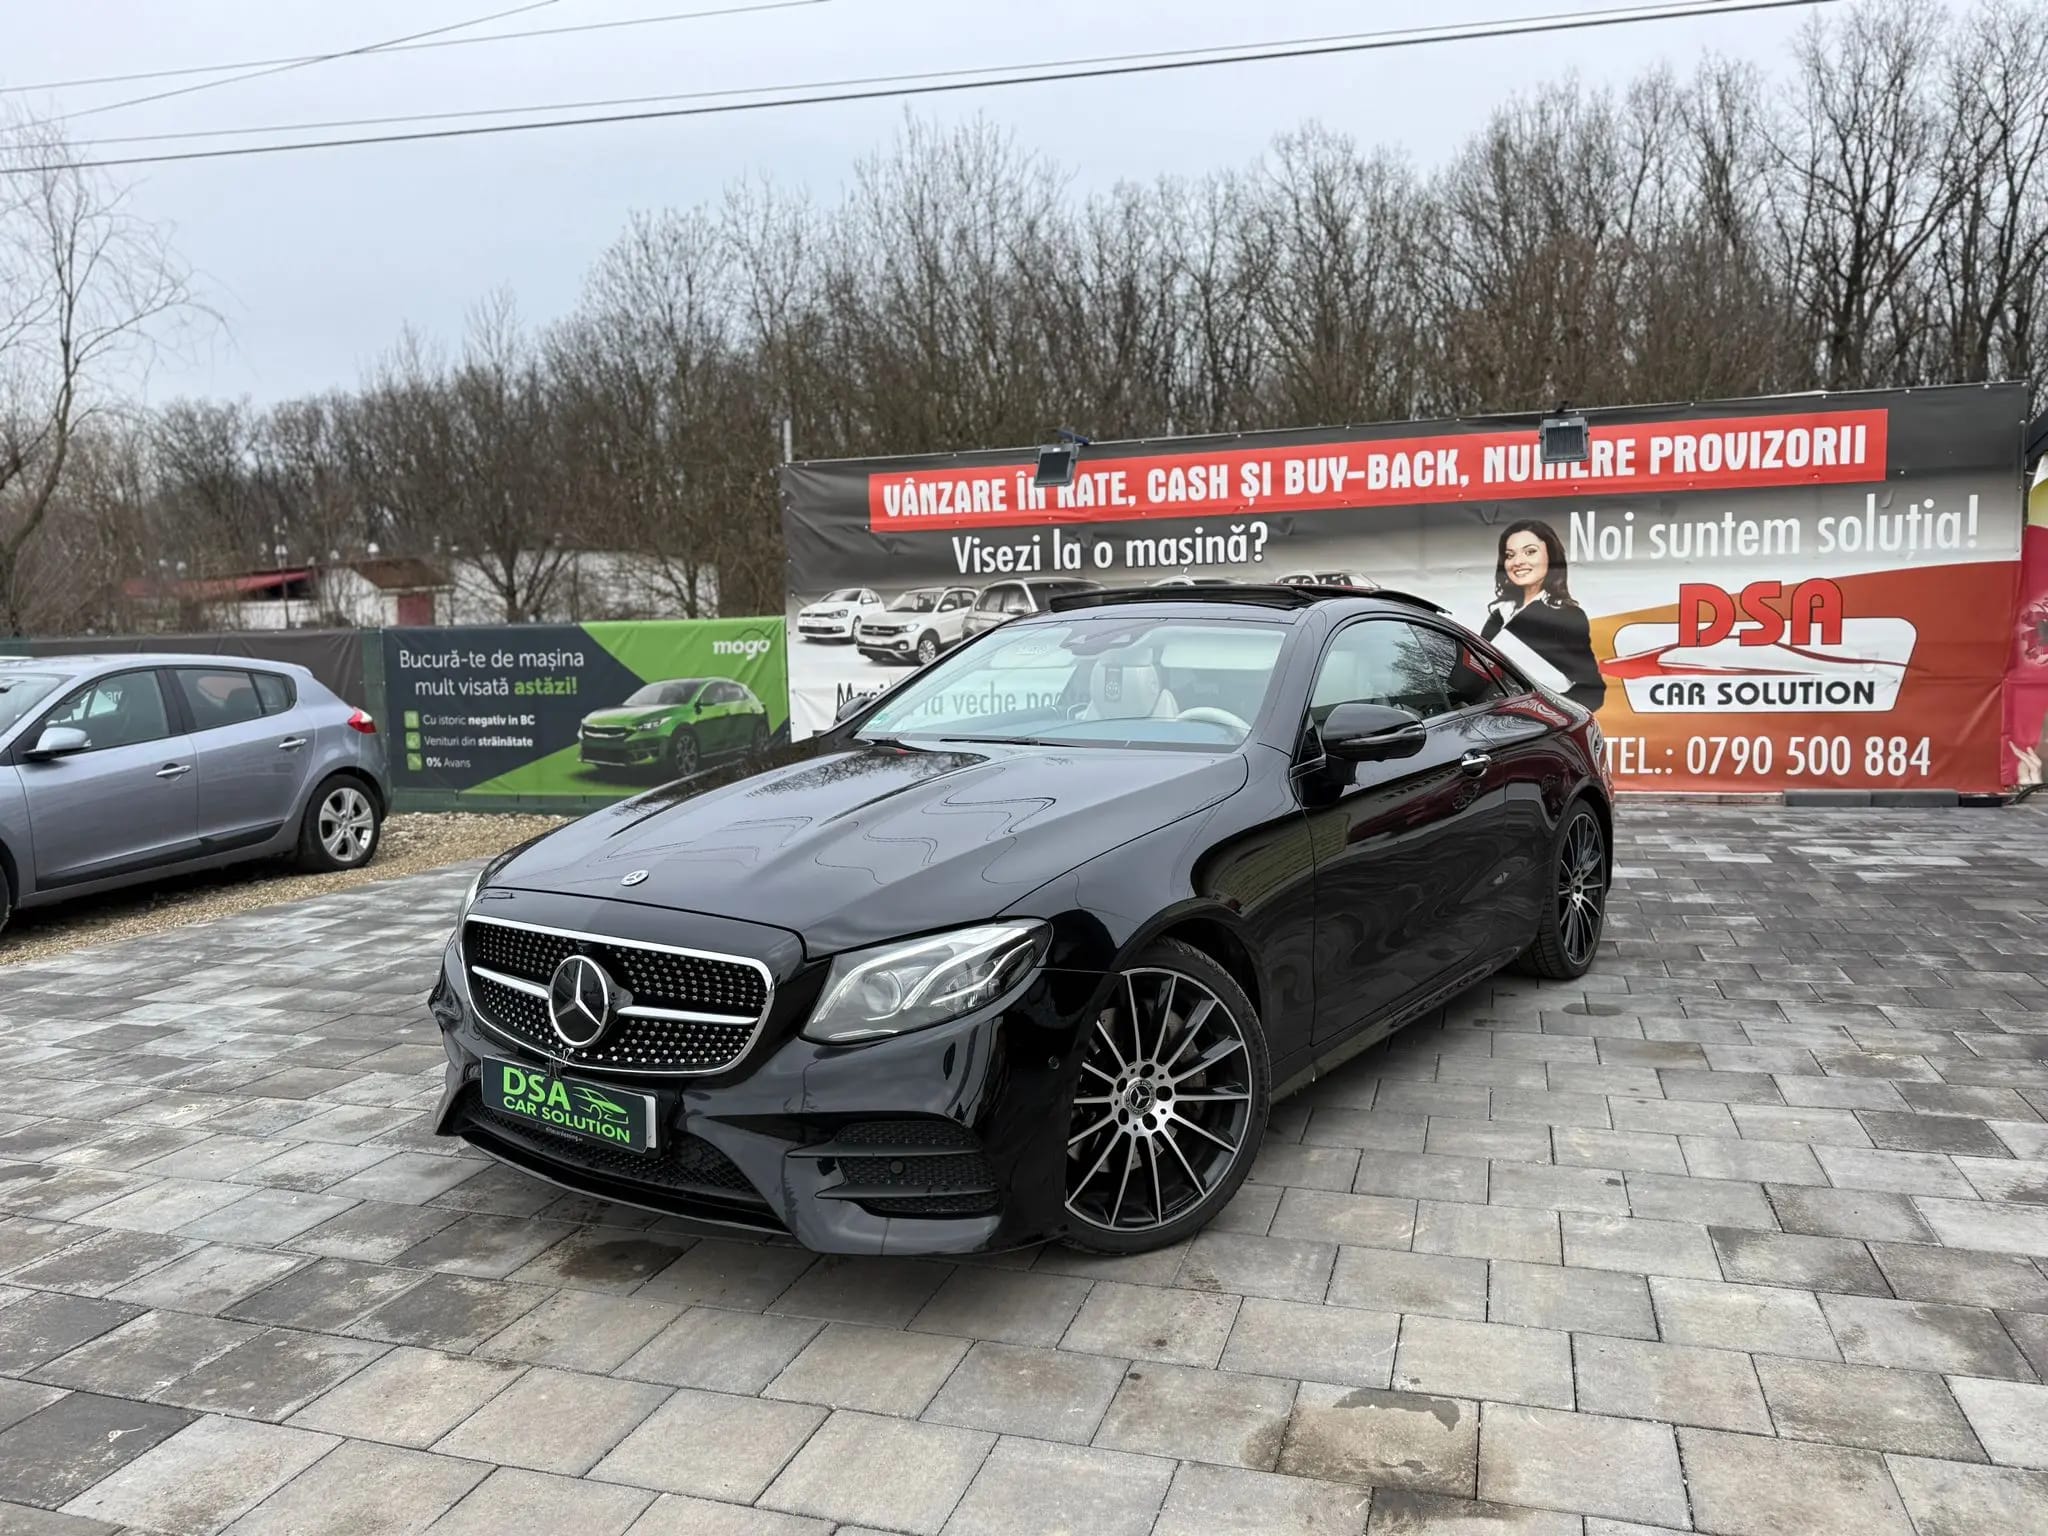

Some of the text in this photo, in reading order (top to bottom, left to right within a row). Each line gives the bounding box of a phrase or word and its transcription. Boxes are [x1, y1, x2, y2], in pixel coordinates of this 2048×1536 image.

[883, 477, 1007, 517] VÂNZARE
[1147, 464, 1228, 503] CASH
[1240, 461, 1271, 506] ȘI
[1284, 449, 1469, 497] BUY-BACK,
[1650, 424, 1866, 475] PROVIZORII
[1570, 493, 1979, 562] Noi suntem soluția!
[952, 534, 1041, 574] Visezi
[1053, 528, 1081, 570] la
[1094, 540, 1113, 569] o
[1679, 578, 1843, 648] DSA
[400, 648, 584, 671] Bucură-te de mașina
[712, 639, 770, 661] mogo
[415, 676, 578, 696] mult visată astăzi!
[1650, 681, 1875, 706] CAR SOLUTION
[423, 714, 436, 726] Cu
[438, 714, 466, 726] istoric
[468, 714, 506, 728] negativ
[520, 715, 536, 726] BC
[424, 736, 459, 747] Venituri
[461, 736, 476, 747] din
[1603, 736, 1931, 776] TEL.: 0790 500 884
[426, 757, 471, 768] 0% Avans
[503, 1066, 571, 1112] DSA
[503, 1096, 537, 1116] CAR
[541, 1107, 631, 1144] SOLUTION
